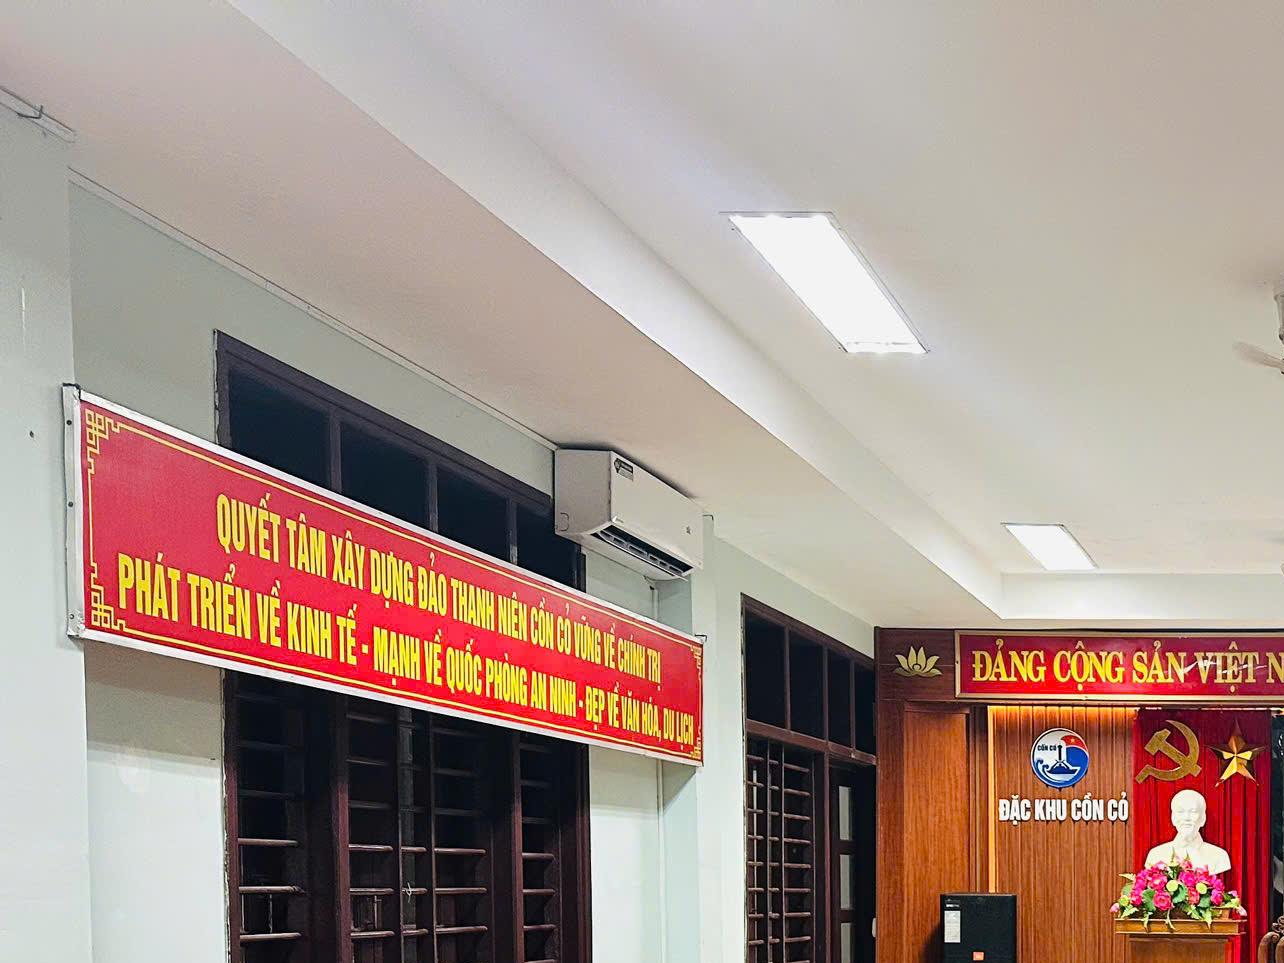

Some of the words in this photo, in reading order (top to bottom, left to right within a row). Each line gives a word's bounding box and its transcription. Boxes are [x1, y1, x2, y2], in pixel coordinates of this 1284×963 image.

[117, 552, 182, 622] PHÁT
[187, 563, 252, 640] TRIỂN
[256, 579, 282, 646] VỀ
[287, 601, 332, 659] KINH
[336, 603, 357, 666] TẾ
[373, 626, 420, 686] MẠNH
[424, 627, 442, 686] VỀ
[445, 639, 482, 695] QUỐC
[485, 654, 527, 705] PHÒNG
[530, 670, 547, 711] AN
[549, 676, 577, 718] NINH
[585, 687, 605, 730] ĐẸP
[607, 681, 620, 726] VỀ
[621, 687, 640, 732] VĂN
[642, 695, 661, 742] HÓA,
[663, 706, 675, 741] DU
[676, 711, 695, 751] LỊCH
[216, 493, 281, 563] QUYẾT
[285, 511, 327, 578] TÂM
[332, 530, 365, 589] XÂY
[370, 549, 414, 607] DỰNG
[418, 553, 447, 616] ĐẢO
[451, 578, 495, 629] THANH
[498, 592, 527, 640] NIÊN
[530, 597, 554, 651] CỒN
[557, 604, 572, 656] CỎ
[574, 615, 601, 665] VỮNG
[602, 624, 616, 667] VỀ
[617, 634, 645, 679] CHÍNH
[646, 647, 661, 691] TRỊ
[972, 638, 1046, 682] ĐẢNG
[1053, 641, 1125, 691] CỘNG
[1132, 638, 1186, 683] SẢN
[1194, 641, 1259, 693] VIỆT
[998, 794, 1031, 826] ĐẶC
[1034, 798, 1067, 821] KHU
[1107, 791, 1129, 821] CỎ
